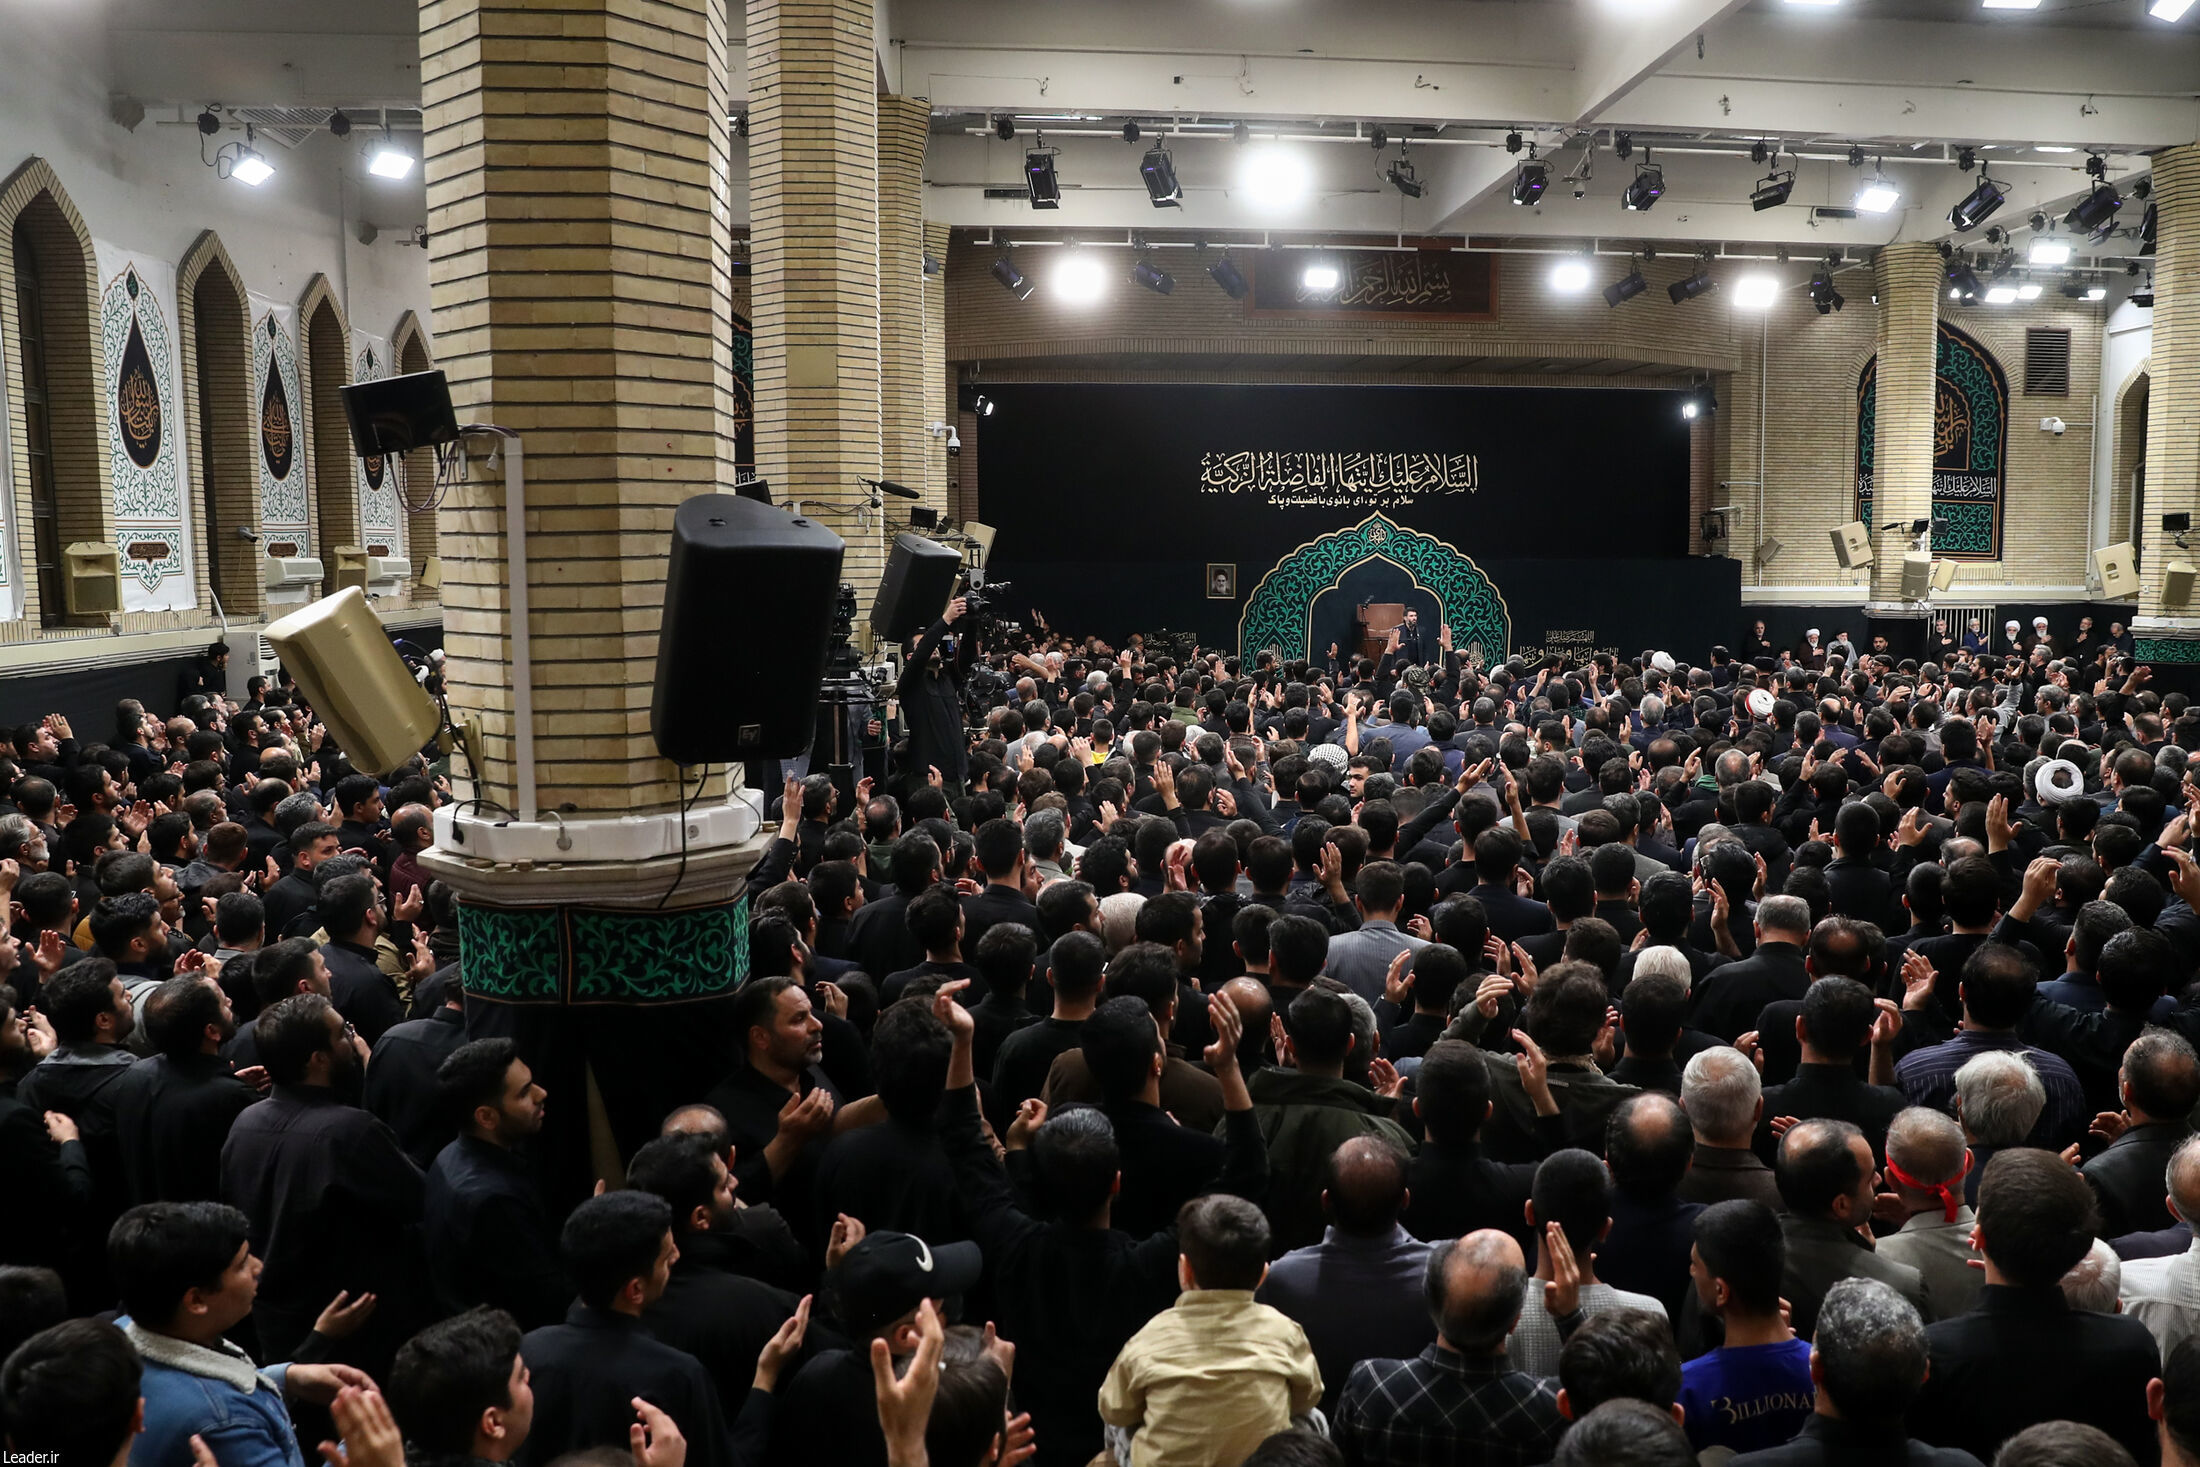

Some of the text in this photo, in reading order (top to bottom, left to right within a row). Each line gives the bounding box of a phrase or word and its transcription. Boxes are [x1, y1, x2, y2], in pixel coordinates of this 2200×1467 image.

[1267, 495, 1284, 510] پاک
[1290, 493, 1318, 508] فضیلت
[1318, 495, 1326, 508] با
[1326, 495, 1351, 508] بانوی
[1353, 497, 1363, 506] ای
[1380, 497, 1390, 508] بر
[1393, 495, 1414, 509] سلام
